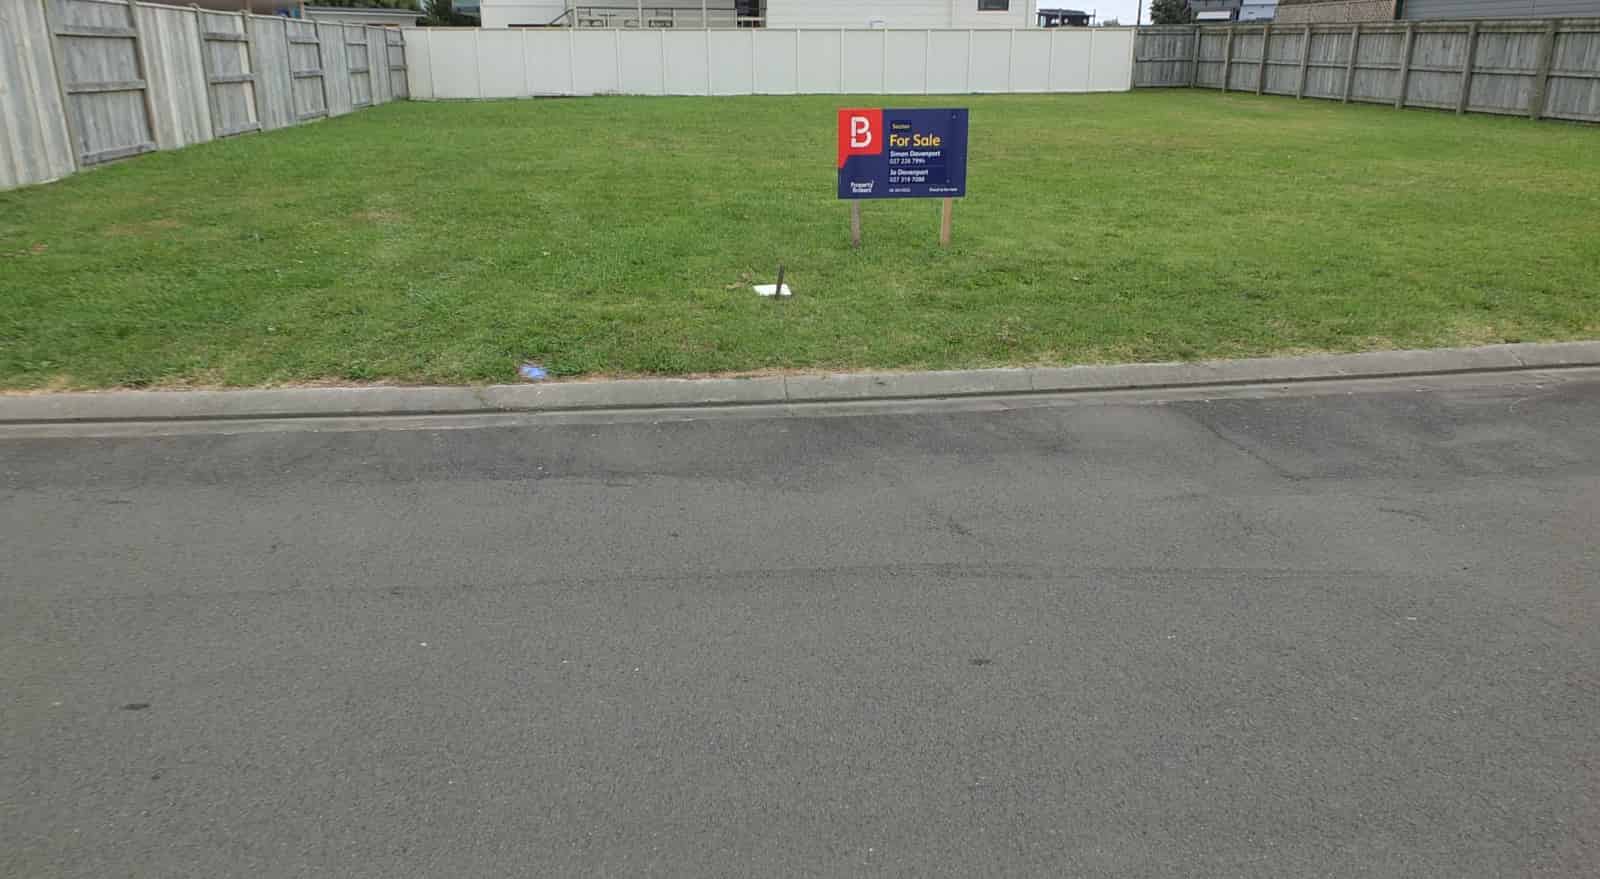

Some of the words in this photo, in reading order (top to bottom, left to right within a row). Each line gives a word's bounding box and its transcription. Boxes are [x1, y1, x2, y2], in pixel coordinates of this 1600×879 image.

[890, 134, 910, 147] For
[913, 133, 941, 147] Sale
[910, 150, 940, 158] Davenport
[897, 169, 929, 177] Davenport
[850, 179, 874, 188] Property
